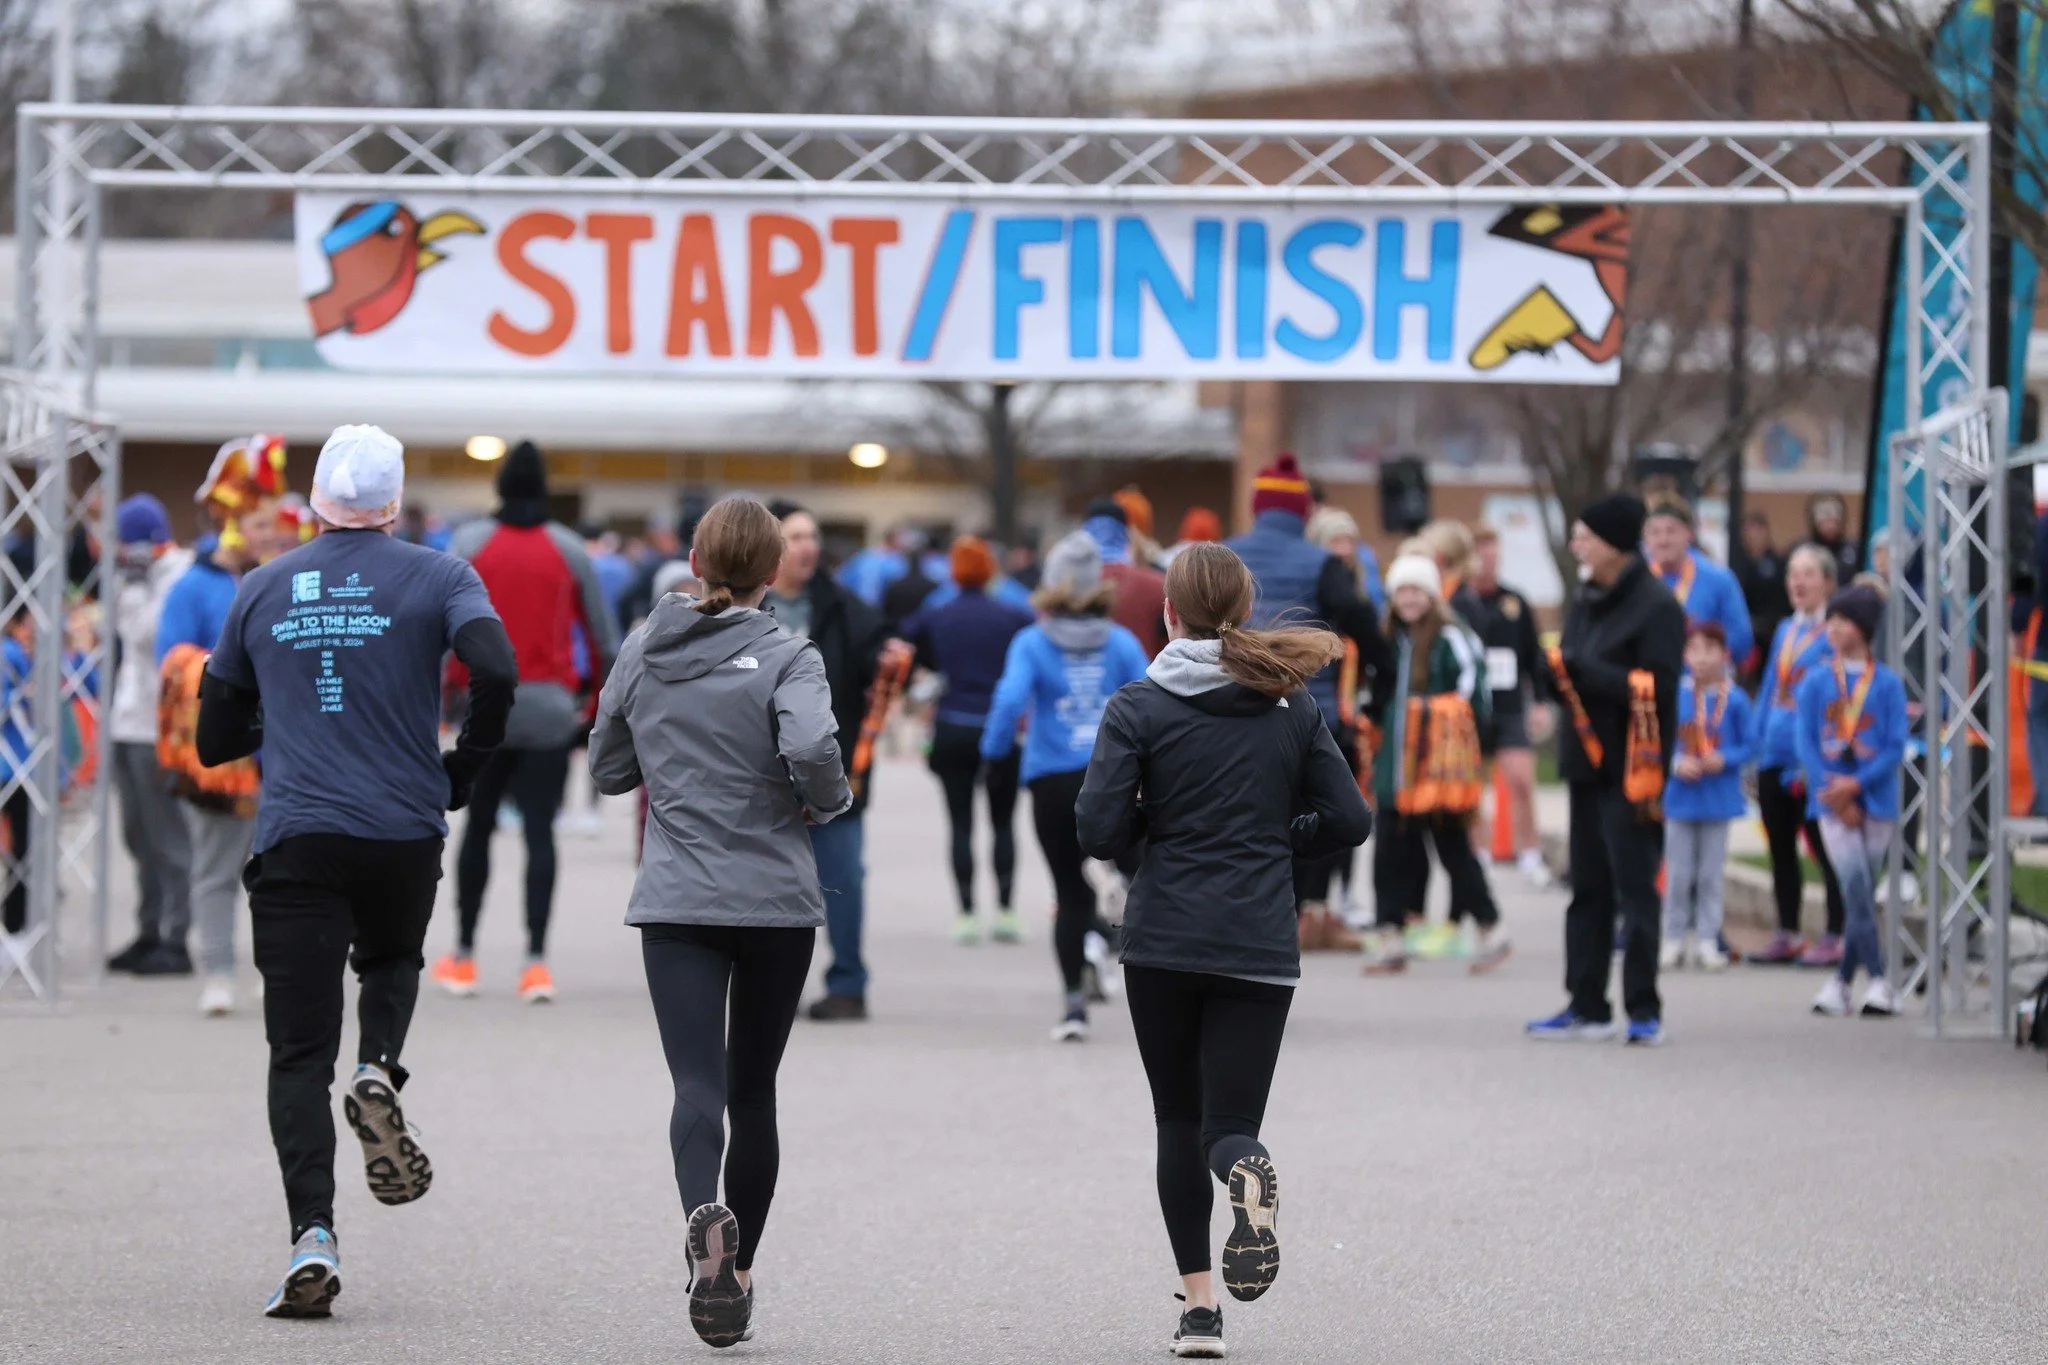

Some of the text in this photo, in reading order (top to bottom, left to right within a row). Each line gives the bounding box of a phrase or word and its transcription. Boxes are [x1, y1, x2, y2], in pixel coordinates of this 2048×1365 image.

[486, 208, 1460, 362] START/FINISH
[287, 605, 337, 618] CELEBRATING
[347, 604, 373, 613] YEARS
[271, 615, 392, 636] SWIM TO THE MOON
[276, 627, 385, 643] OPEN WATER SWIM FESTIVAL
[293, 639, 321, 650] AUGUST
[343, 638, 365, 647] 2024
[326, 676, 344, 685] MILE
[326, 685, 344, 694] MILE
